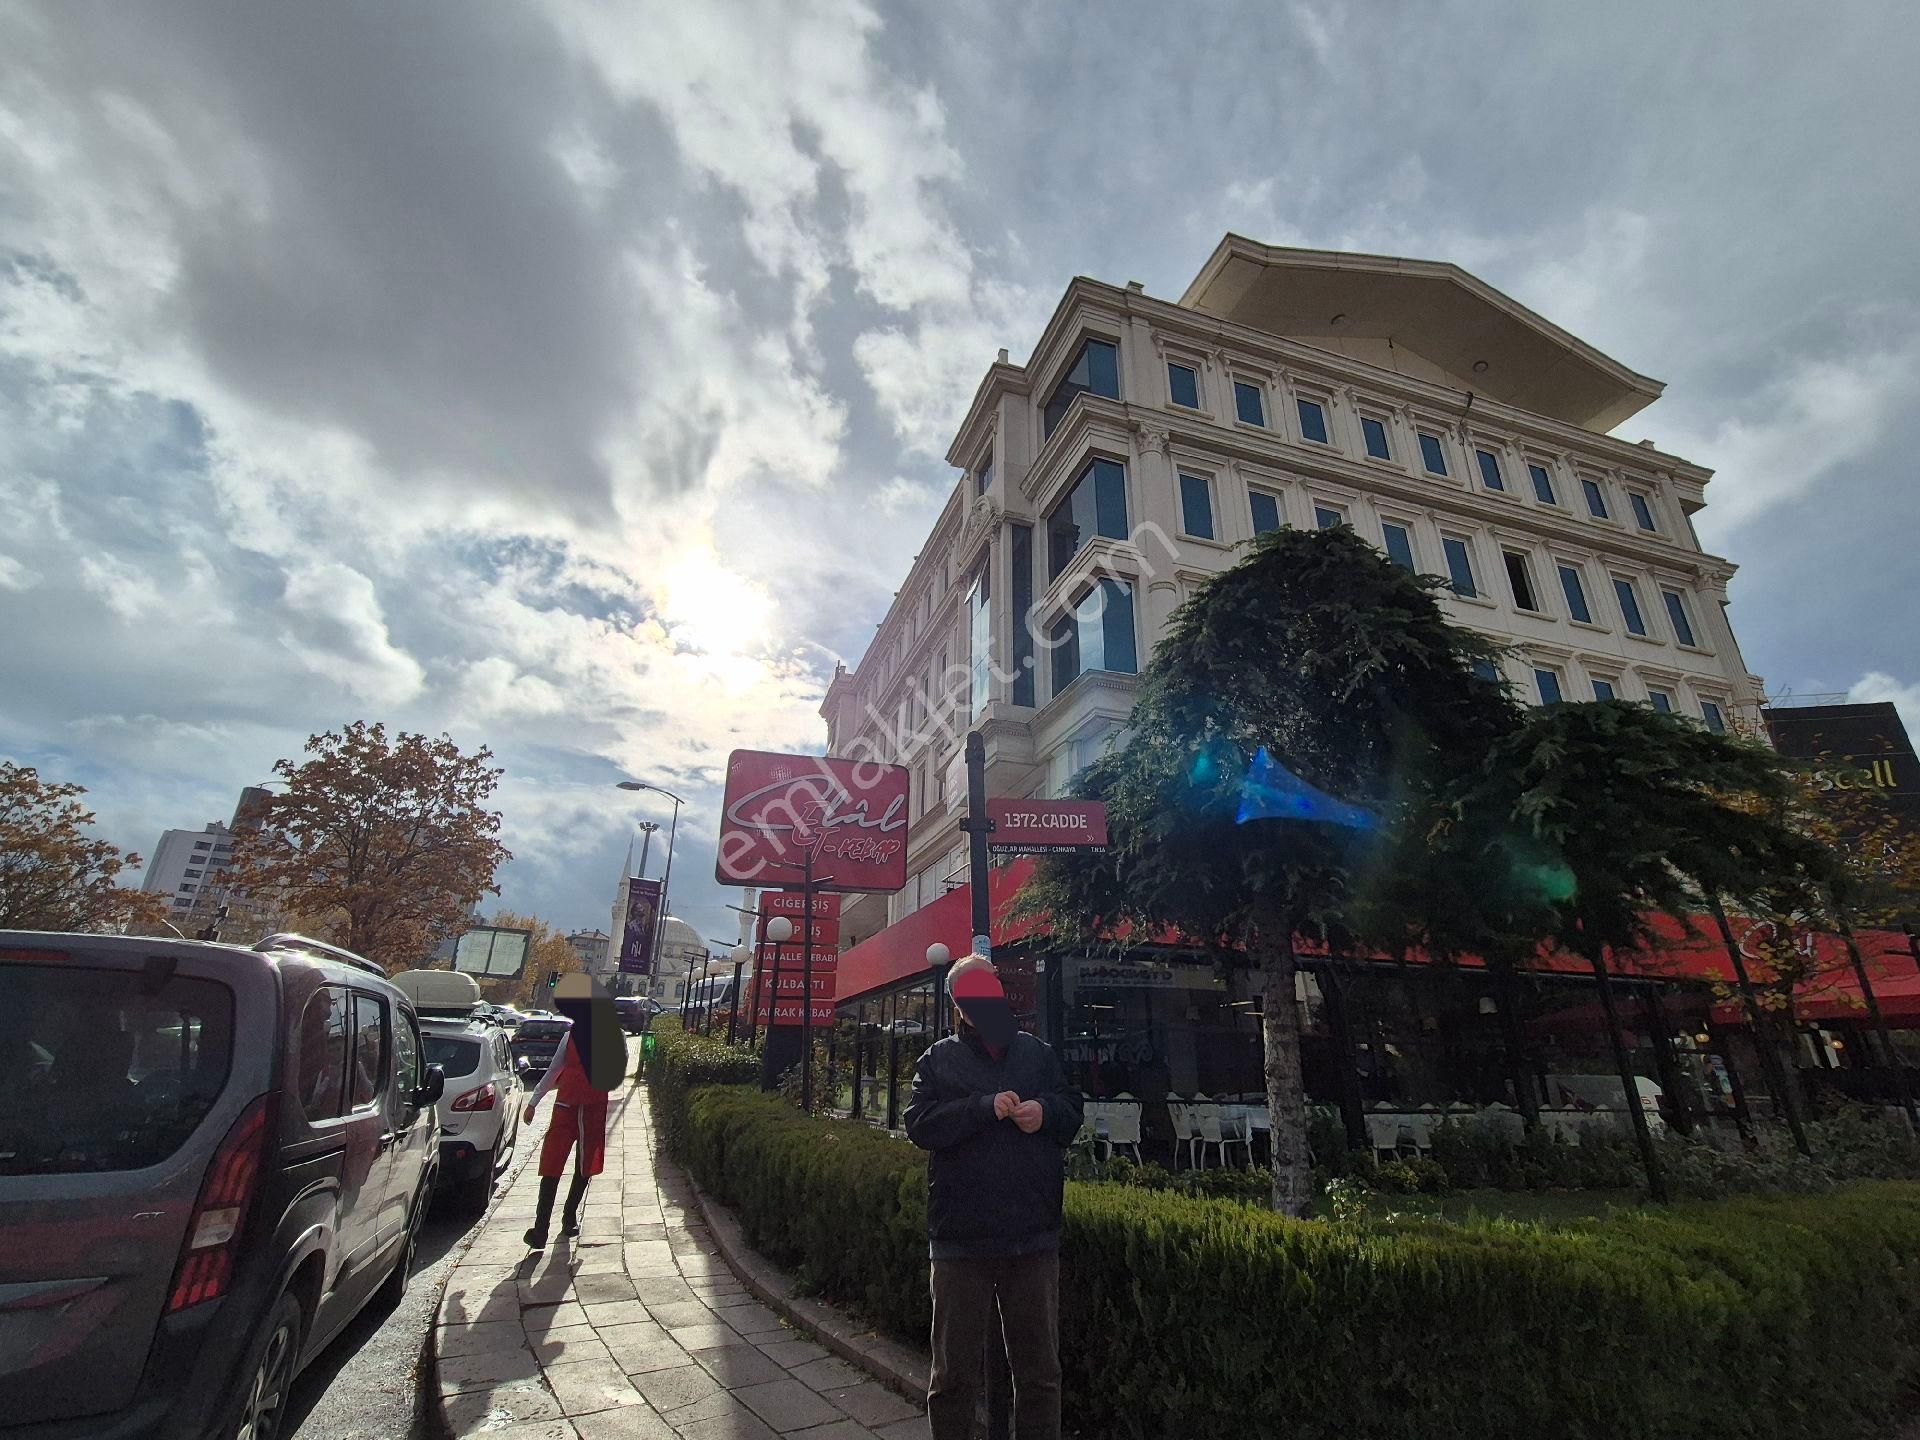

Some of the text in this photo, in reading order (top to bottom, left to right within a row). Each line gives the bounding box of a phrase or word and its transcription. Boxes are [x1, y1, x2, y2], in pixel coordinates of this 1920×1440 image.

[1004, 813, 1088, 829] 1372.CADDE
[811, 899, 830, 913] ŞİŞ
[810, 954, 837, 963] EBABI
[765, 977, 825, 990] KÜLBATI
[798, 1008, 832, 1018] KBAP
